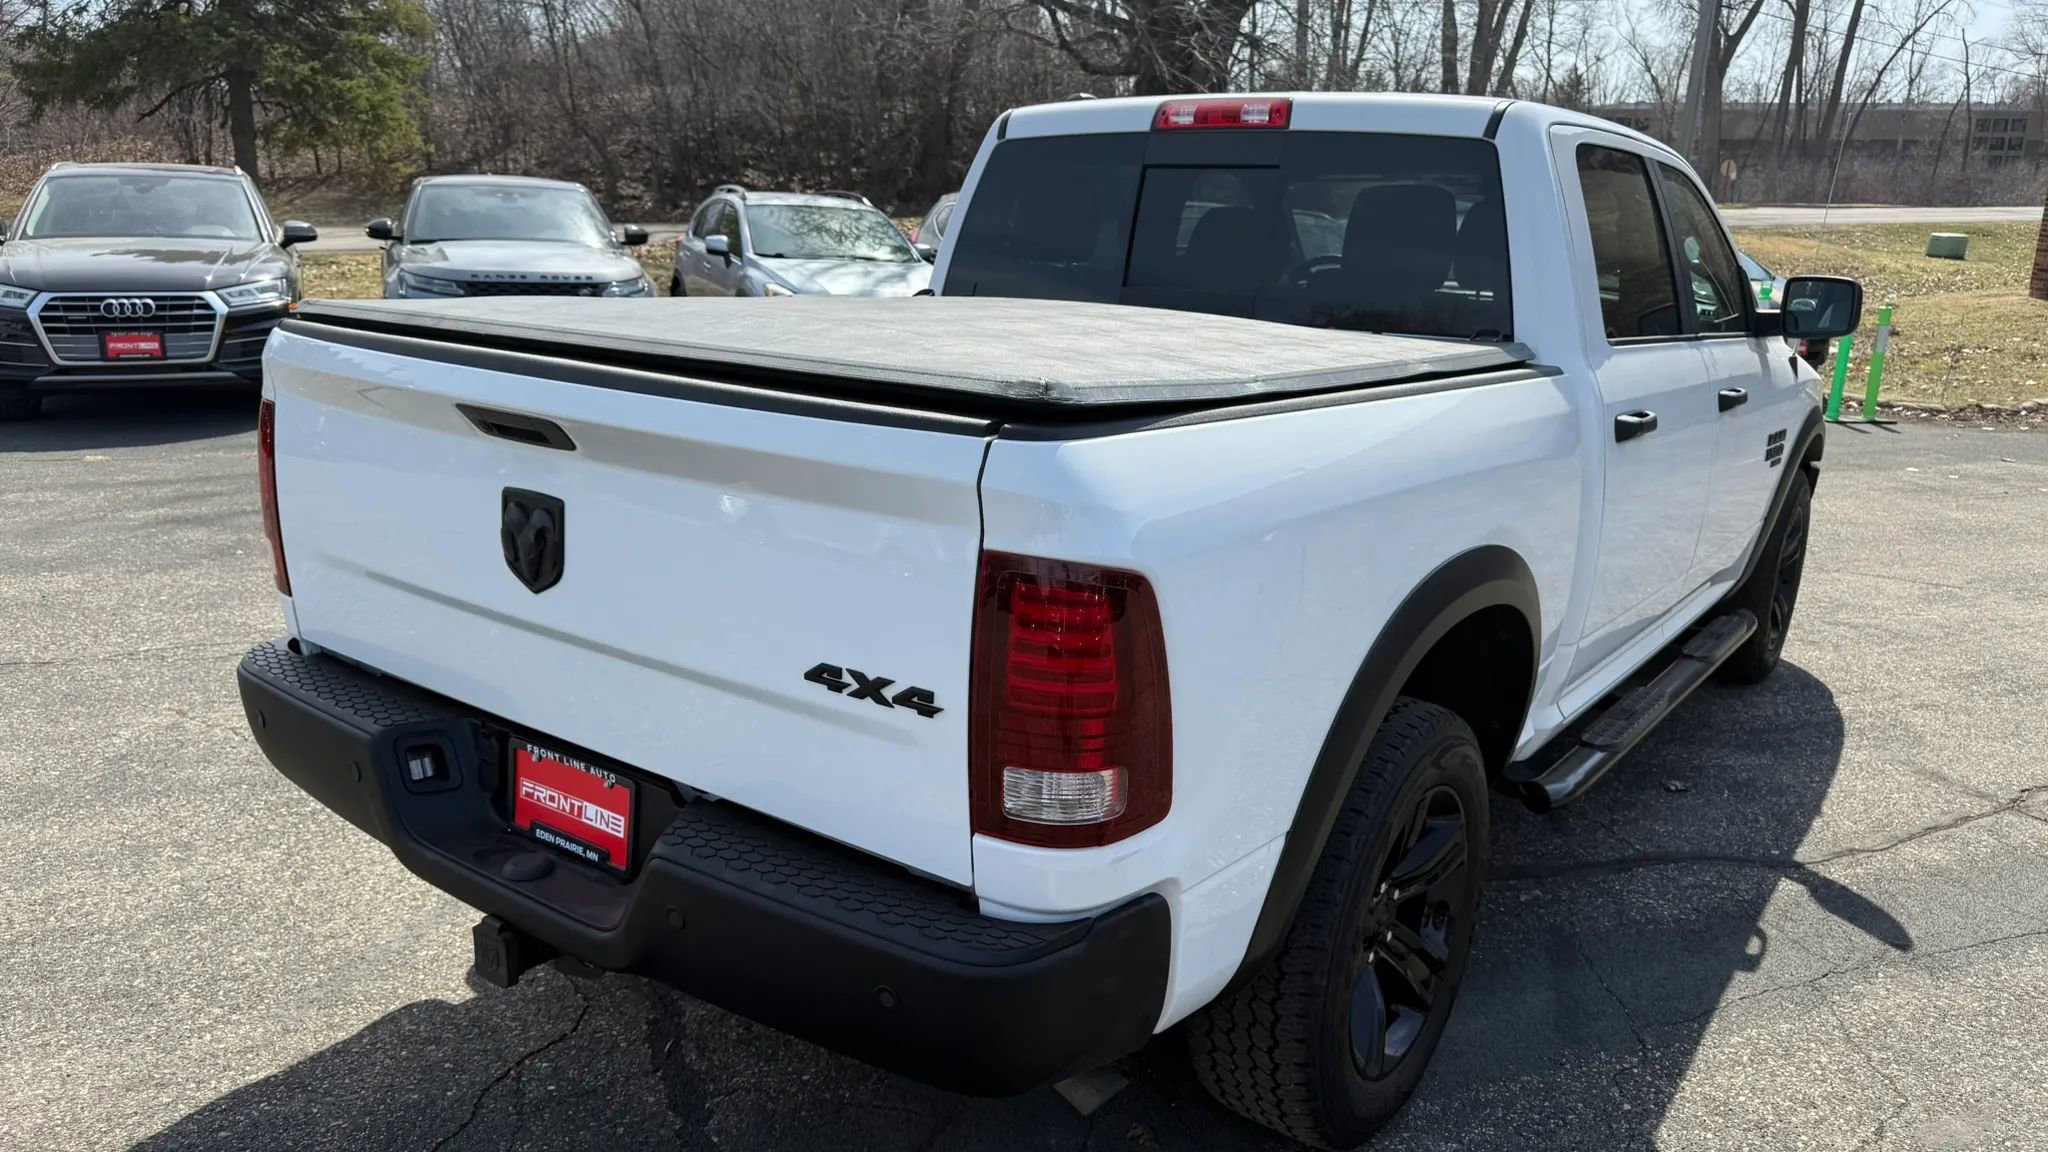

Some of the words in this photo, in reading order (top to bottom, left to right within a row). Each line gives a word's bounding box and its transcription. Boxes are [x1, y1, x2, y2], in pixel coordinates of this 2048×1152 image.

[804, 662, 944, 719] 4X4
[526, 744, 563, 761] FRONT
[564, 756, 586, 772] LINE
[590, 767, 616, 783] AUTO
[521, 781, 623, 835] FRONTLINE
[536, 828, 555, 844] EDEN
[555, 836, 586, 857] PRAIRIE,
[586, 848, 599, 862] MN
